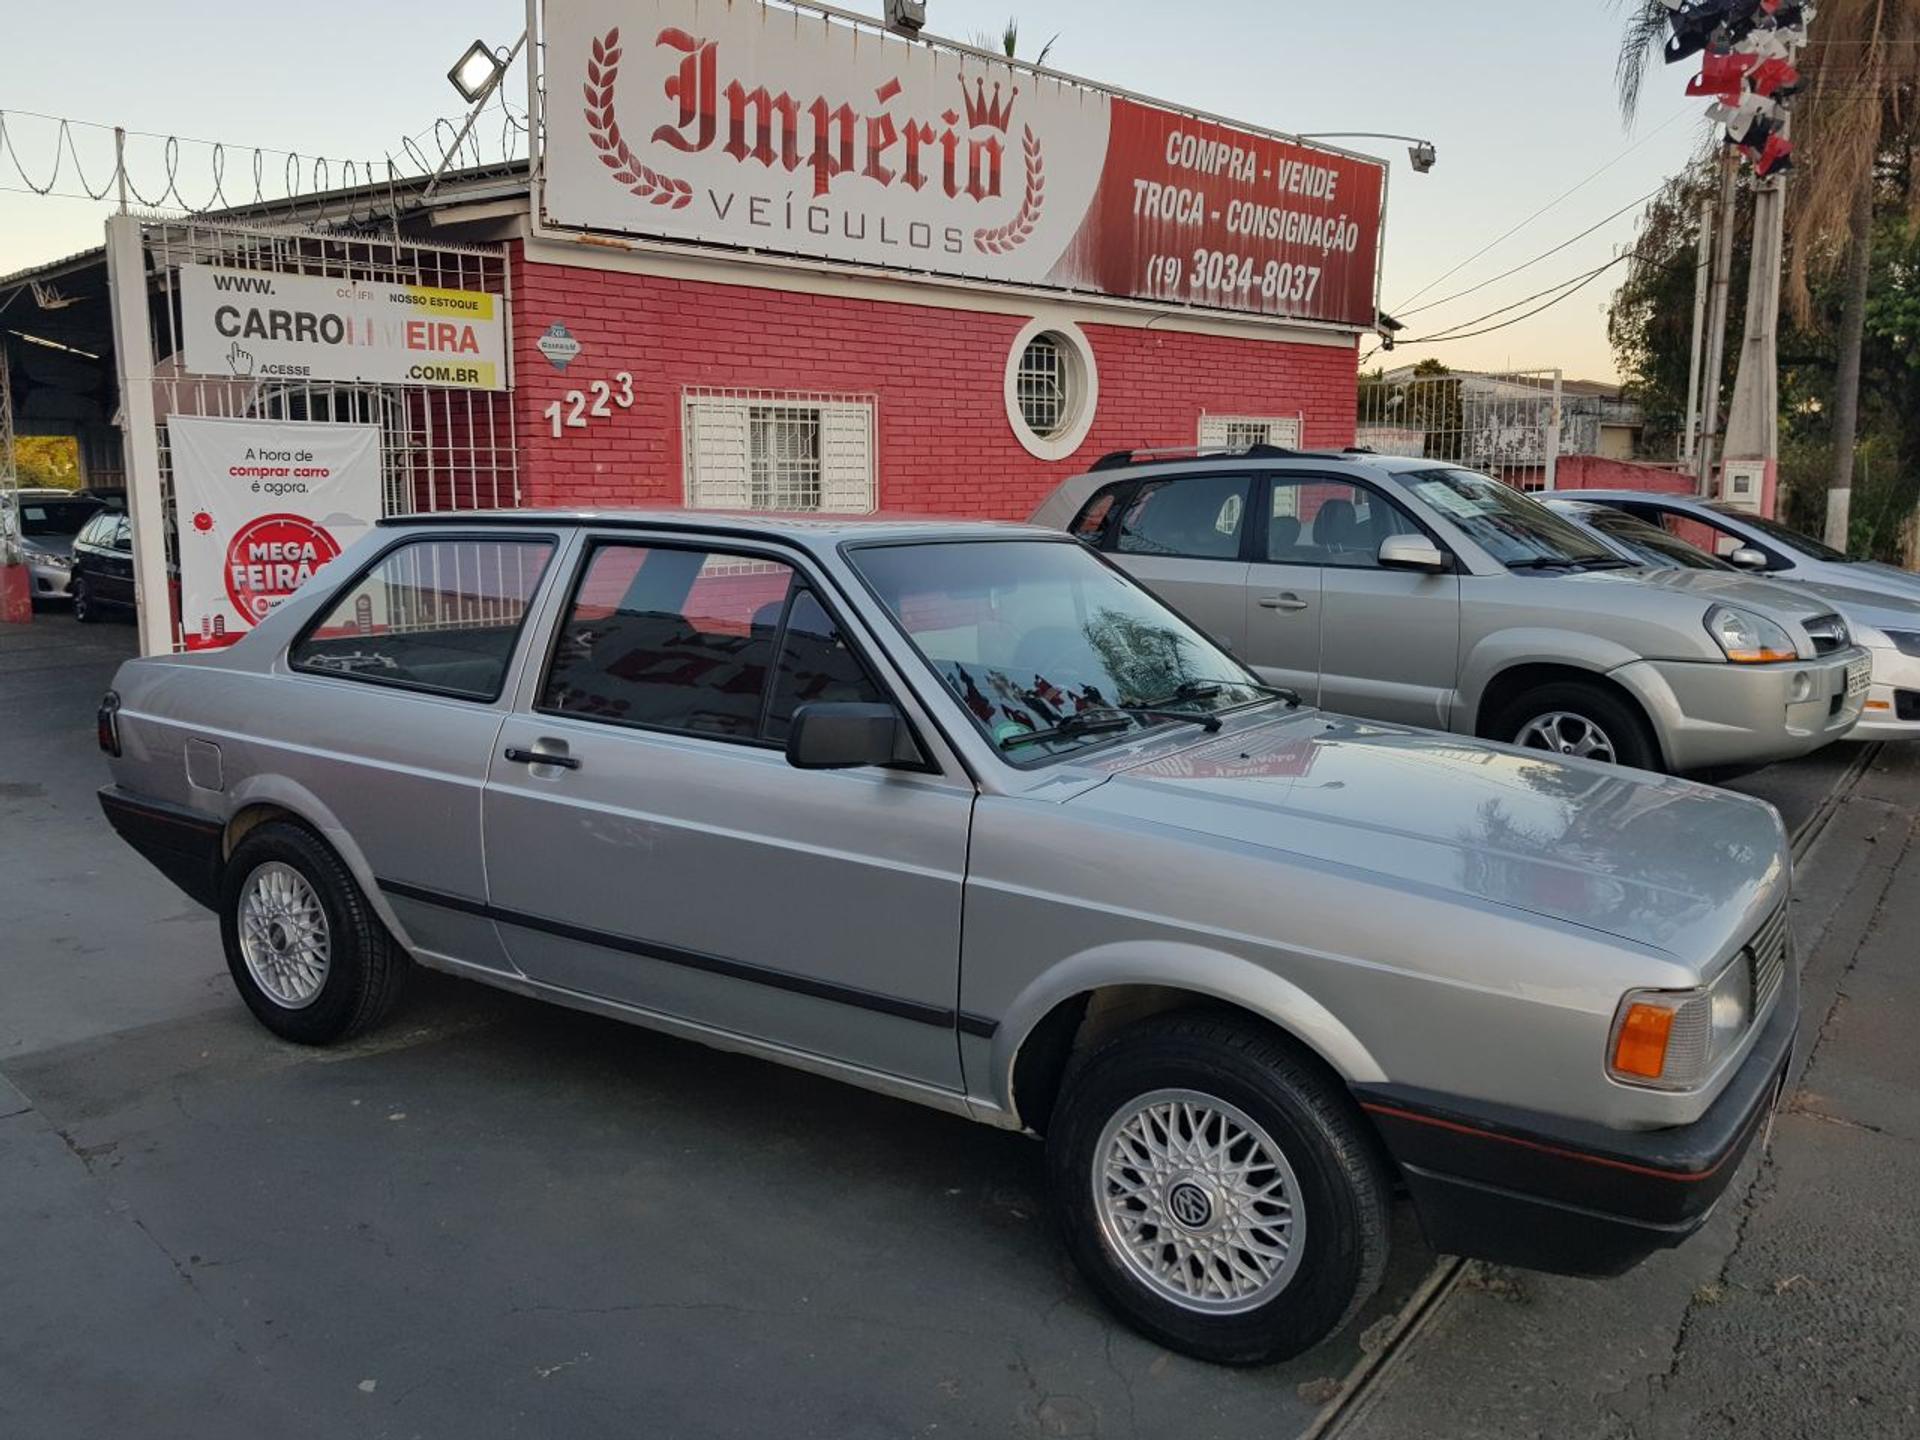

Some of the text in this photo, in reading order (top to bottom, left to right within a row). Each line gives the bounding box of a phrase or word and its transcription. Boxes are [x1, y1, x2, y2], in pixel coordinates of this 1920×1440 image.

[651, 27, 1006, 203] Império
[1165, 131, 1257, 184] COMPRA
[1277, 158, 1339, 201] VENDE
[707, 189, 964, 254] VEÍCULOS
[1134, 179, 1205, 226] TROCA
[1226, 199, 1359, 257] CONSIGNAÇÃO
[1147, 248, 1321, 301] (19) 3034-8037
[389, 293, 427, 305] NOSSO
[430, 297, 479, 311] ESTOQUE
[260, 364, 311, 376] ACESSE
[405, 364, 479, 384] .COM.BR
[544, 371, 635, 438] 1223
[245, 448, 313, 462] A hora de
[229, 466, 330, 479] comprar carro
[251, 480, 309, 496] é agora.
[248, 541, 318, 561] MEGA
[231, 559, 328, 592] FEIRÃ
